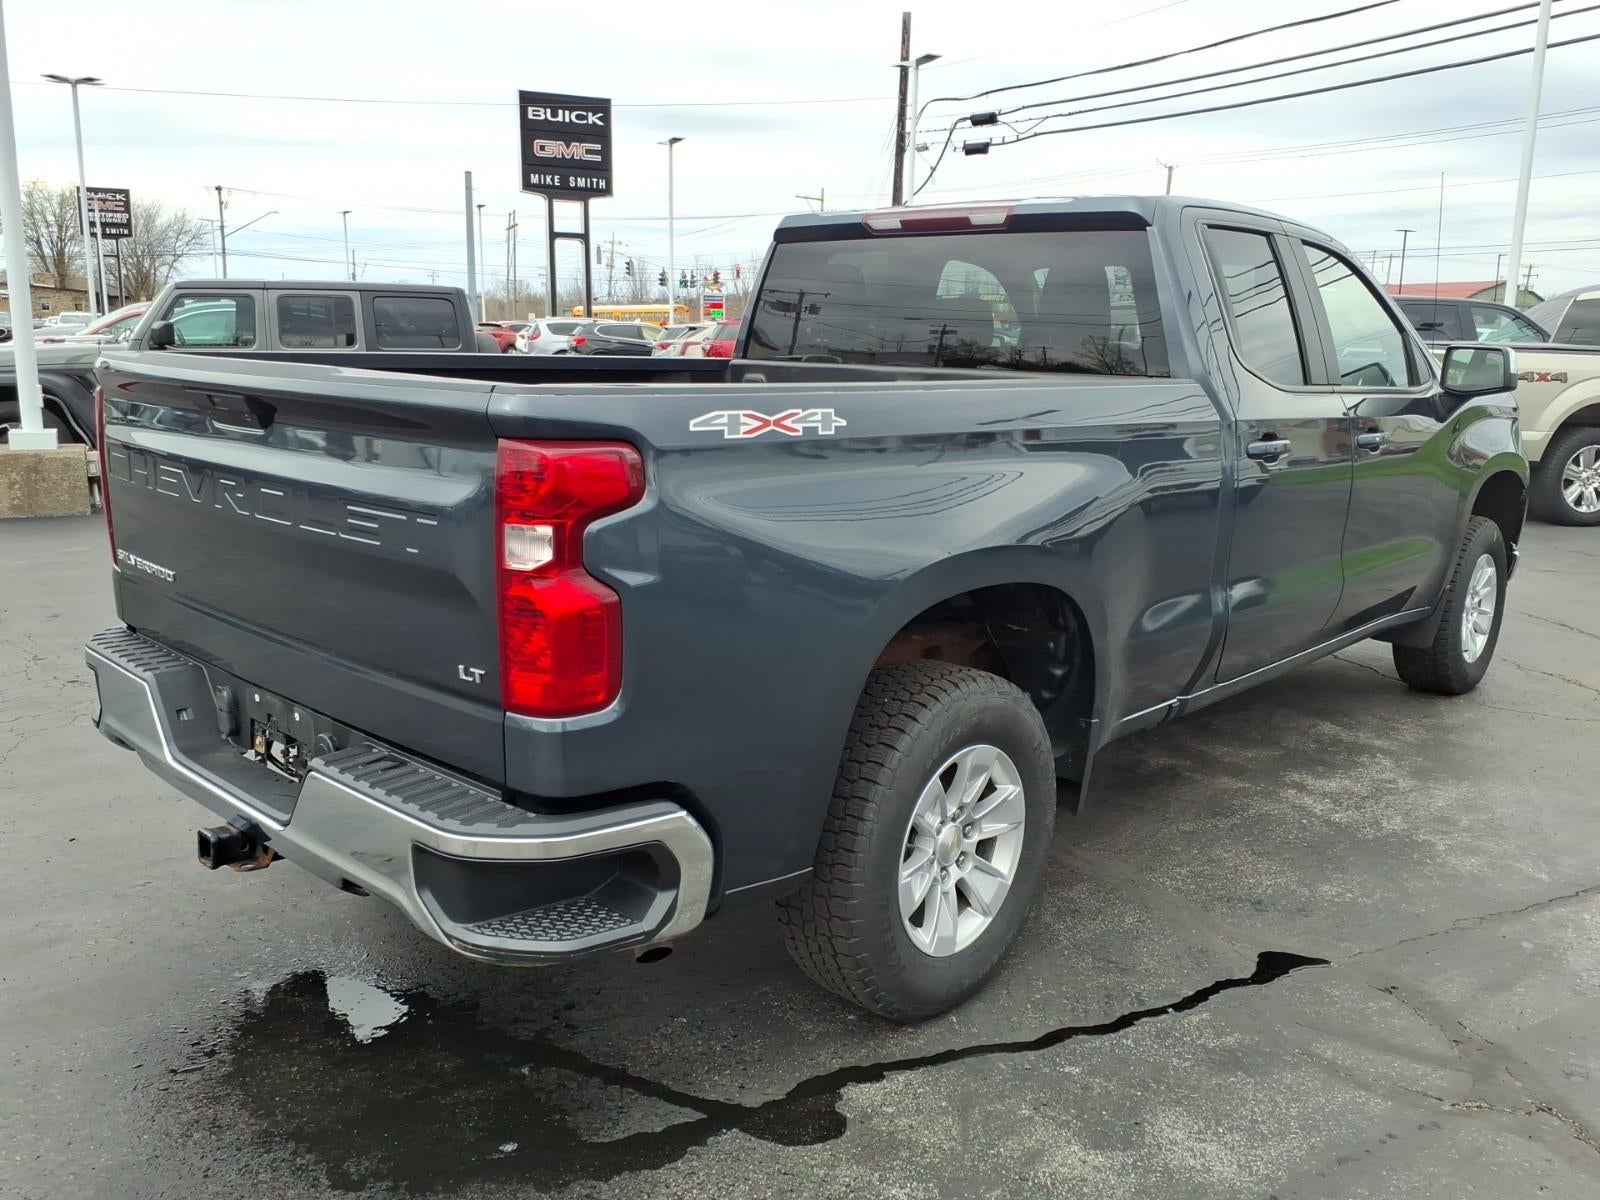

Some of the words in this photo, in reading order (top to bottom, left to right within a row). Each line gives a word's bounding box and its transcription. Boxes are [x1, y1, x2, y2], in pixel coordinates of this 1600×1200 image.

[527, 106, 605, 126] BUICK
[533, 139, 602, 162] GMC
[530, 173, 561, 186] MIKE
[569, 176, 606, 189] SMITH
[105, 227, 129, 235] SMITH
[107, 447, 438, 553] CHEVROLET
[116, 548, 176, 582] SILVERADO
[458, 664, 486, 684] LT
